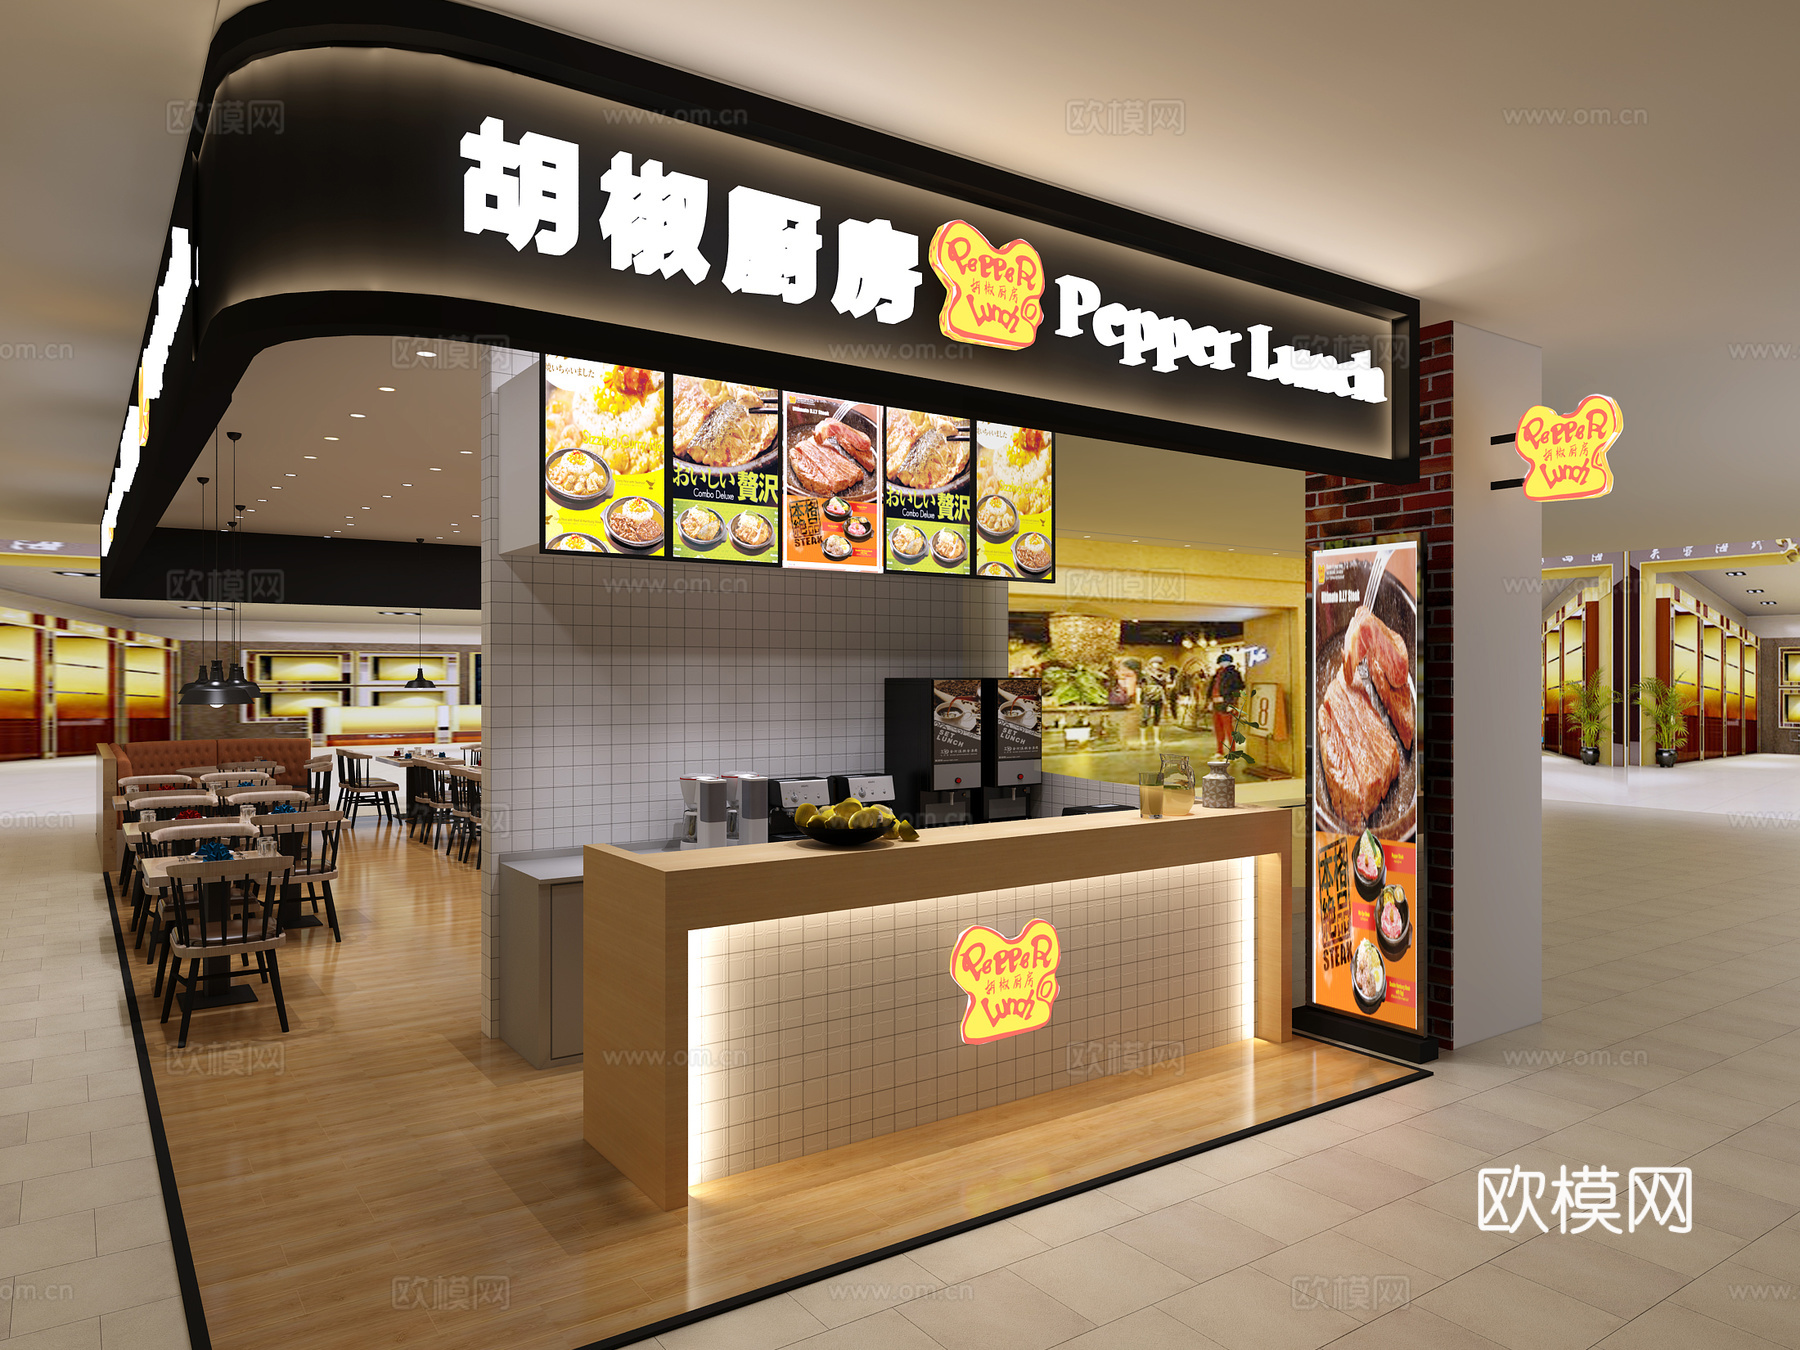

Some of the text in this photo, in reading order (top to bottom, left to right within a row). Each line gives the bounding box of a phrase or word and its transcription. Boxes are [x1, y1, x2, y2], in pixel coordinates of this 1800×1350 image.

[460, 116, 923, 324] 胡椒厨房
[1054, 274, 1388, 404] Pepper Lunch
[582, 429, 617, 450] Sizzling
[693, 487, 735, 500] Combo Deluxe
[902, 507, 919, 518] Combo
[794, 536, 823, 547] STEAK
[939, 729, 955, 739] SET
[1002, 727, 1018, 736] SET
[936, 734, 965, 748] LUNCH
[1000, 733, 1026, 745] LUNCH
[1323, 940, 1353, 972] STEAK
